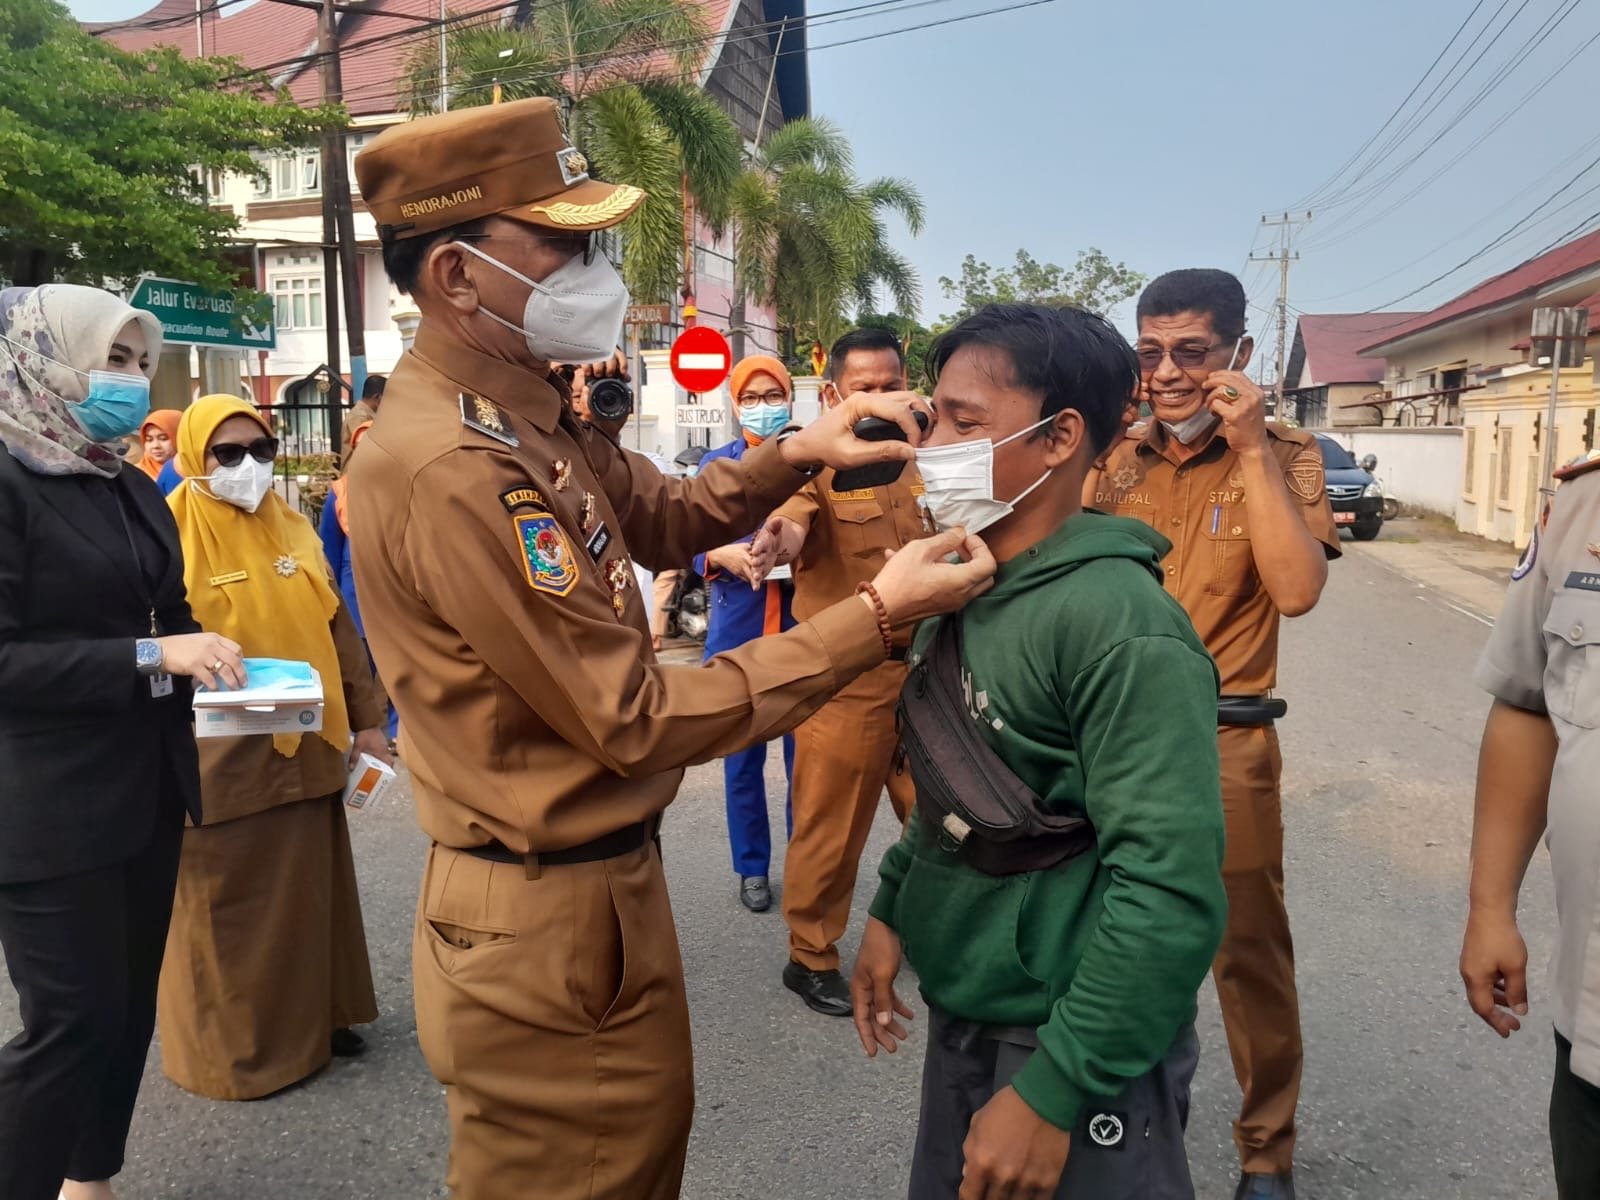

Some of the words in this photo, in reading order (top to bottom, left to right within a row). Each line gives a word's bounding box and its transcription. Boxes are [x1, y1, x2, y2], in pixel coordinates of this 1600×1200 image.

[400, 185, 483, 218] HENDRAJONI
[146, 287, 179, 308] Jalur
[161, 321, 203, 336] vacuation
[677, 409, 694, 424] BUS
[696, 409, 726, 424] TRUCK
[1095, 491, 1151, 505] DAILIPAL
[1209, 491, 1238, 504] STAF
